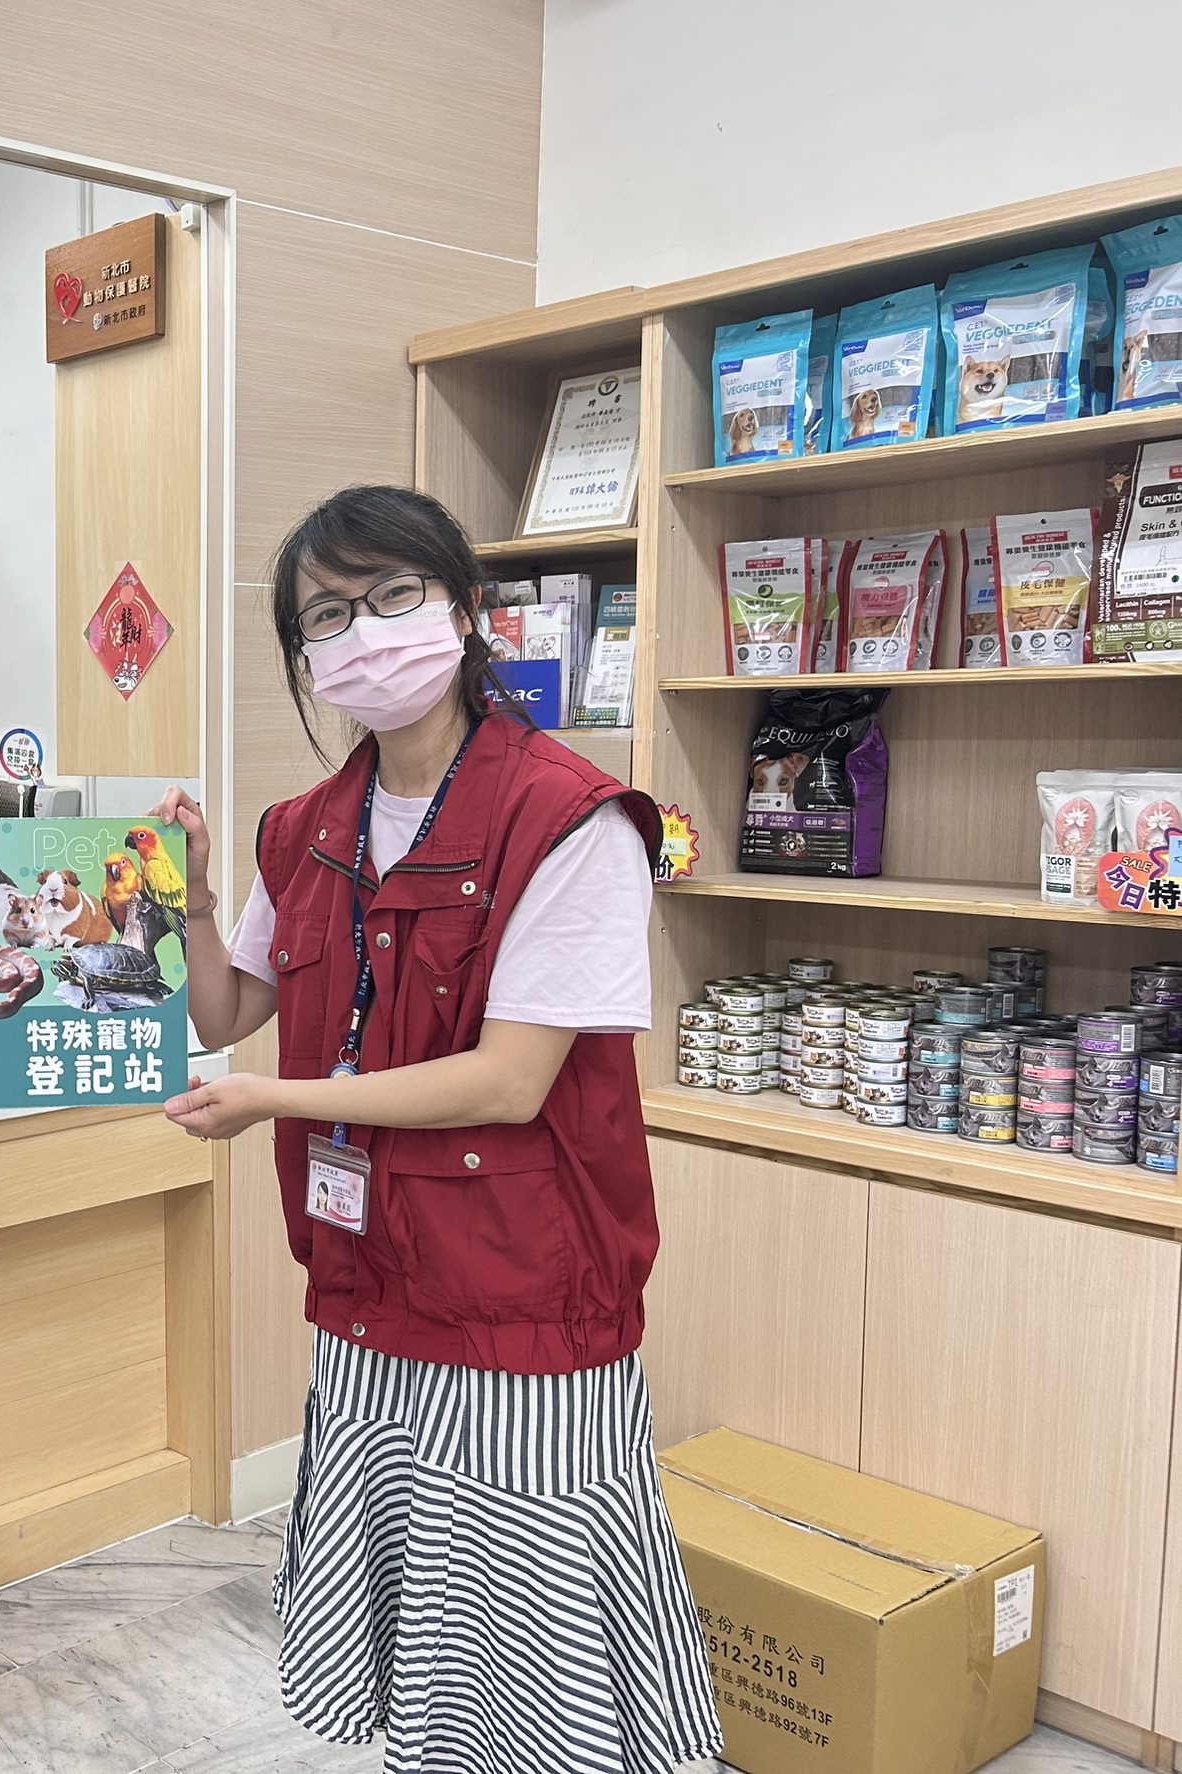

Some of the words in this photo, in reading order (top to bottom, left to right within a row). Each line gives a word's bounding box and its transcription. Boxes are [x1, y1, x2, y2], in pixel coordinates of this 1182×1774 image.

[101, 260, 131, 280] 新北市
[83, 275, 151, 307] 動物保護醫院
[103, 304, 146, 326] 新北市政府
[965, 318, 1055, 343] VEGGIEDENT
[726, 379, 784, 397] VEGGIEDENT
[1141, 522, 1165, 532] Skin
[1169, 519, 1177, 528] &
[1104, 581, 1112, 622] supervised
[1114, 495, 1126, 530] products.
[1020, 579, 1066, 590] 皮毛保健
[1116, 600, 1139, 608] Lecithin
[33, 827, 116, 872] Pet
[830, 862, 837, 870] 2
[837, 863, 847, 871] kg
[1046, 856, 1071, 866] IGOR
[1121, 857, 1152, 872] SALE
[26, 1017, 161, 1052] 特殊寵物
[26, 1052, 162, 1096] 登記站
[697, 1606, 826, 1675] 股份有限公司
[703, 1631, 798, 1688] 512-2518
